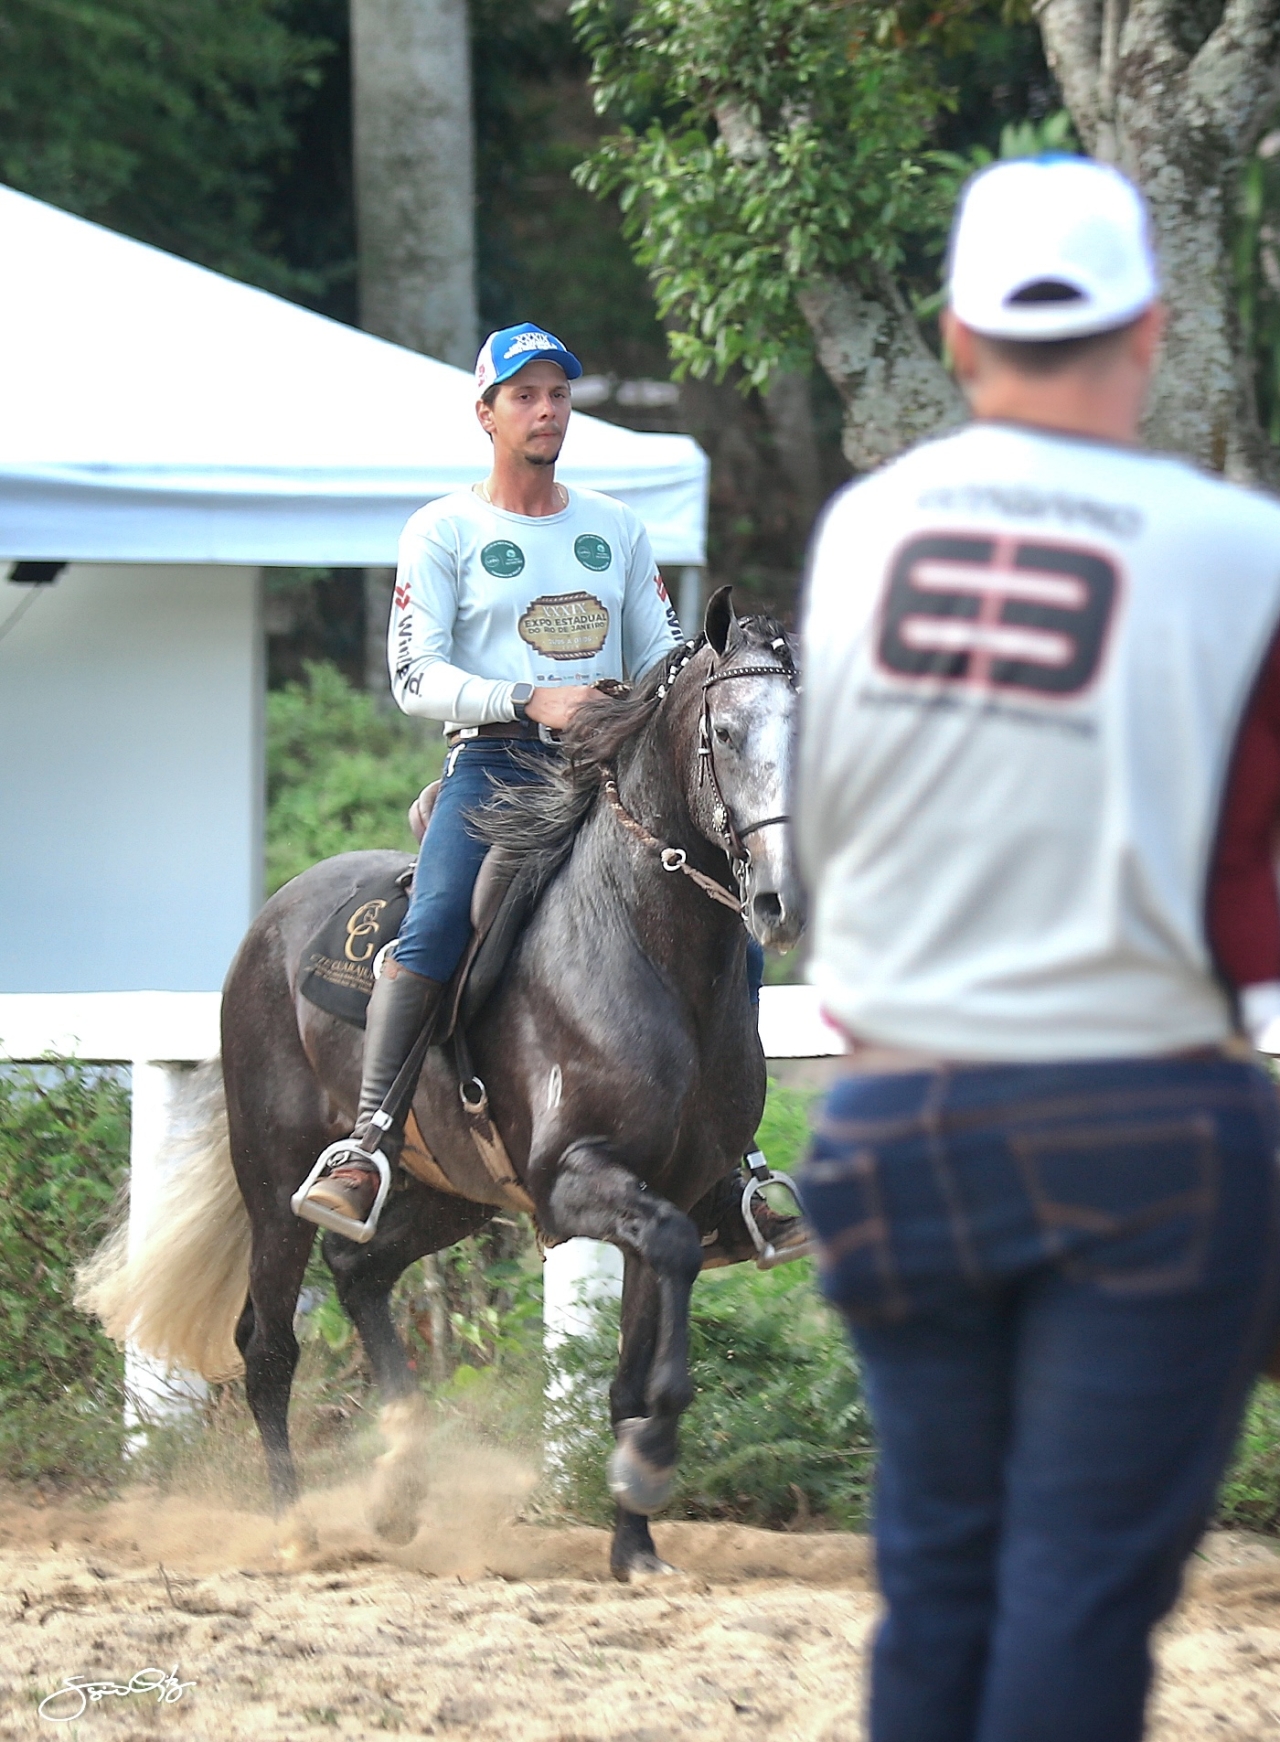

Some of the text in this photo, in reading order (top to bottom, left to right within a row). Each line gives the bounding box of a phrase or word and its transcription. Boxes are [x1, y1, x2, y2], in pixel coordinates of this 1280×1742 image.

[542, 603, 586, 616] XXXIX
[525, 614, 606, 627] EXPO ESTADUAL
[543, 626, 556, 634] RIO
[571, 622, 604, 631] JANEIRO
